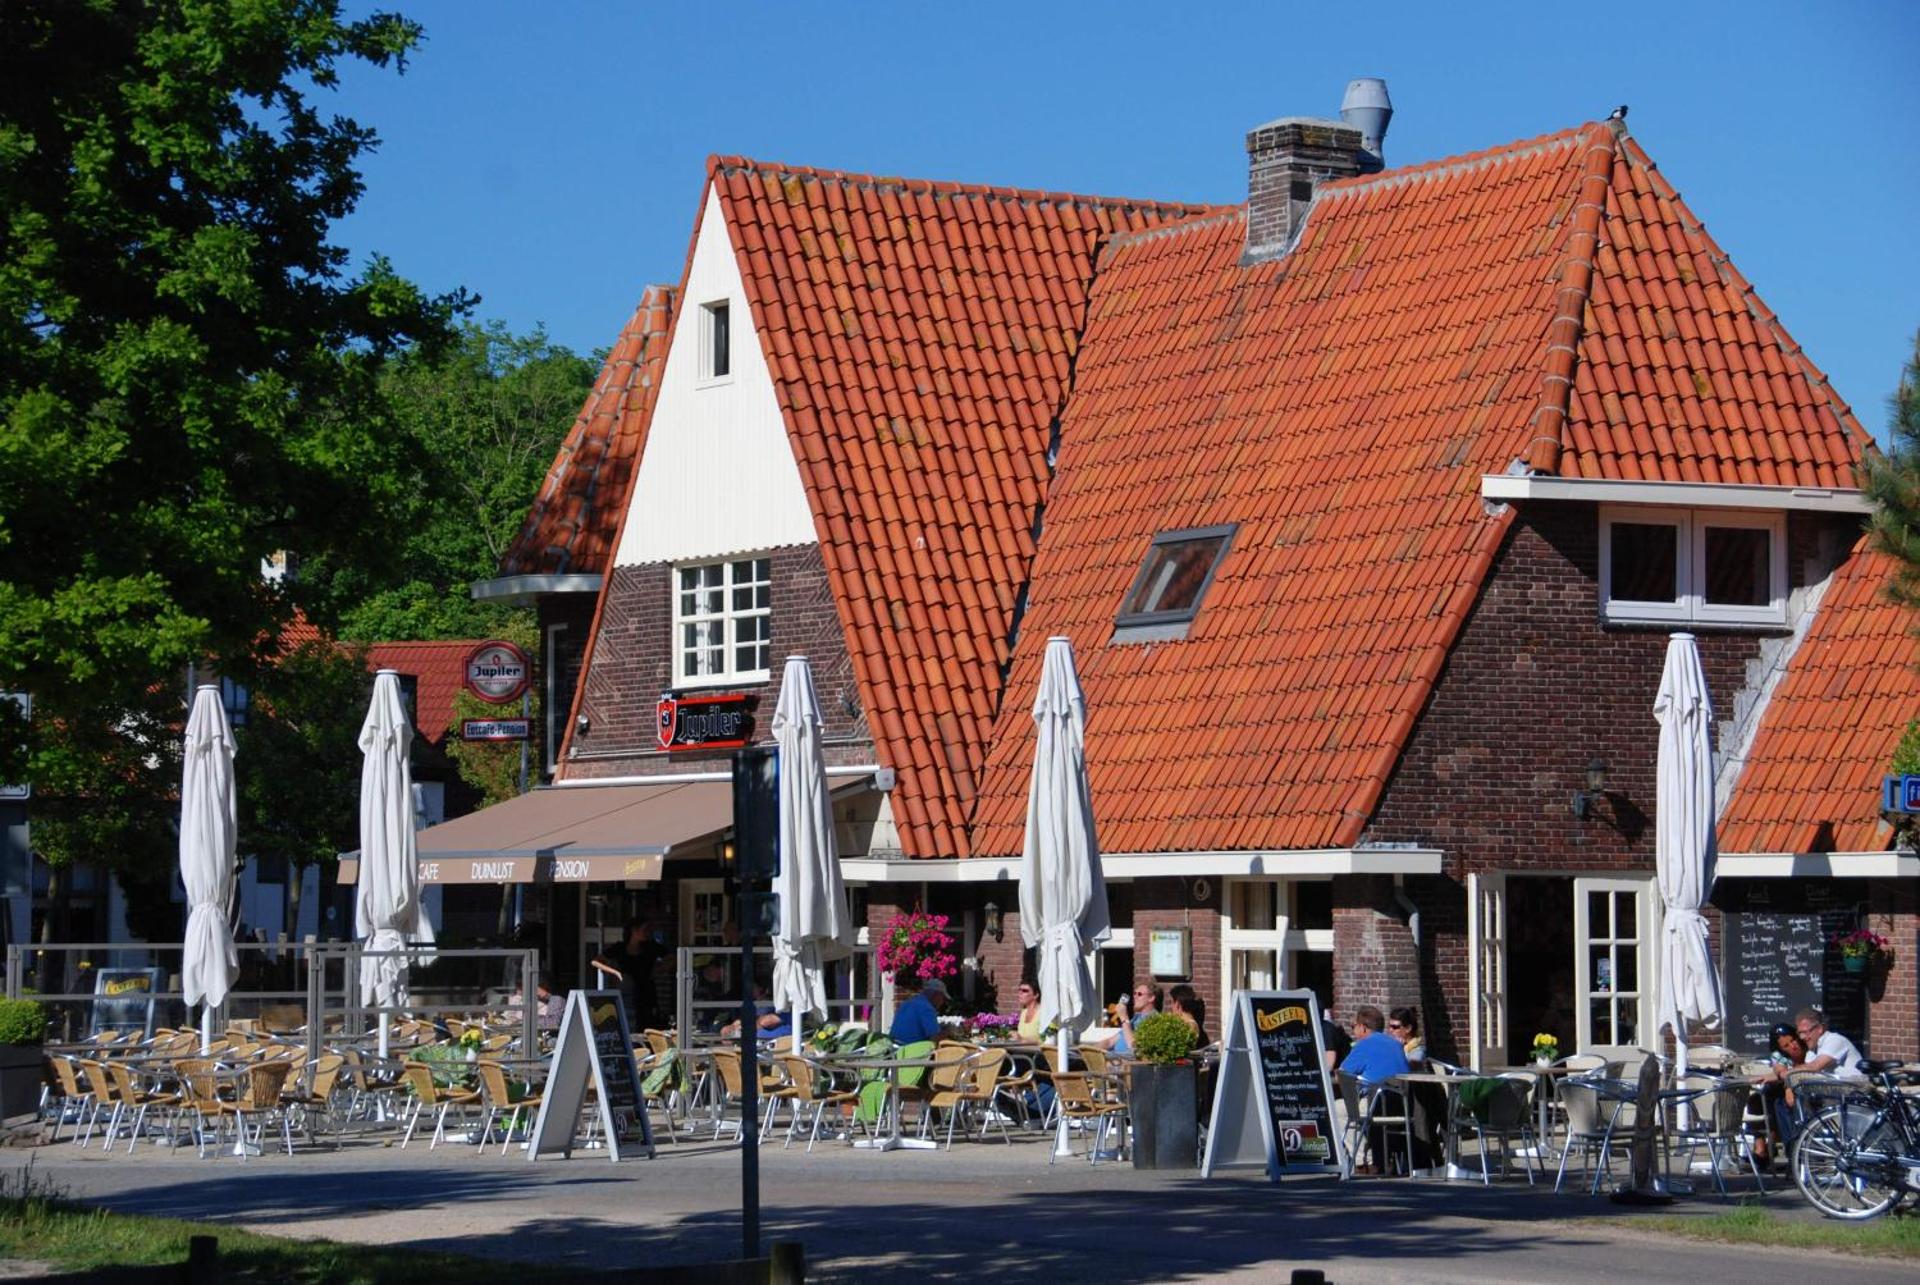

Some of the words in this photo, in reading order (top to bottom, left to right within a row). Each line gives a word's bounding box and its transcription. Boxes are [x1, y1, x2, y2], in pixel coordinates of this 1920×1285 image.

[474, 666, 520, 679] Jupiler
[676, 705, 742, 744] Jupiler
[471, 862, 515, 880] DUINLUST
[548, 860, 590, 879] PENSION
